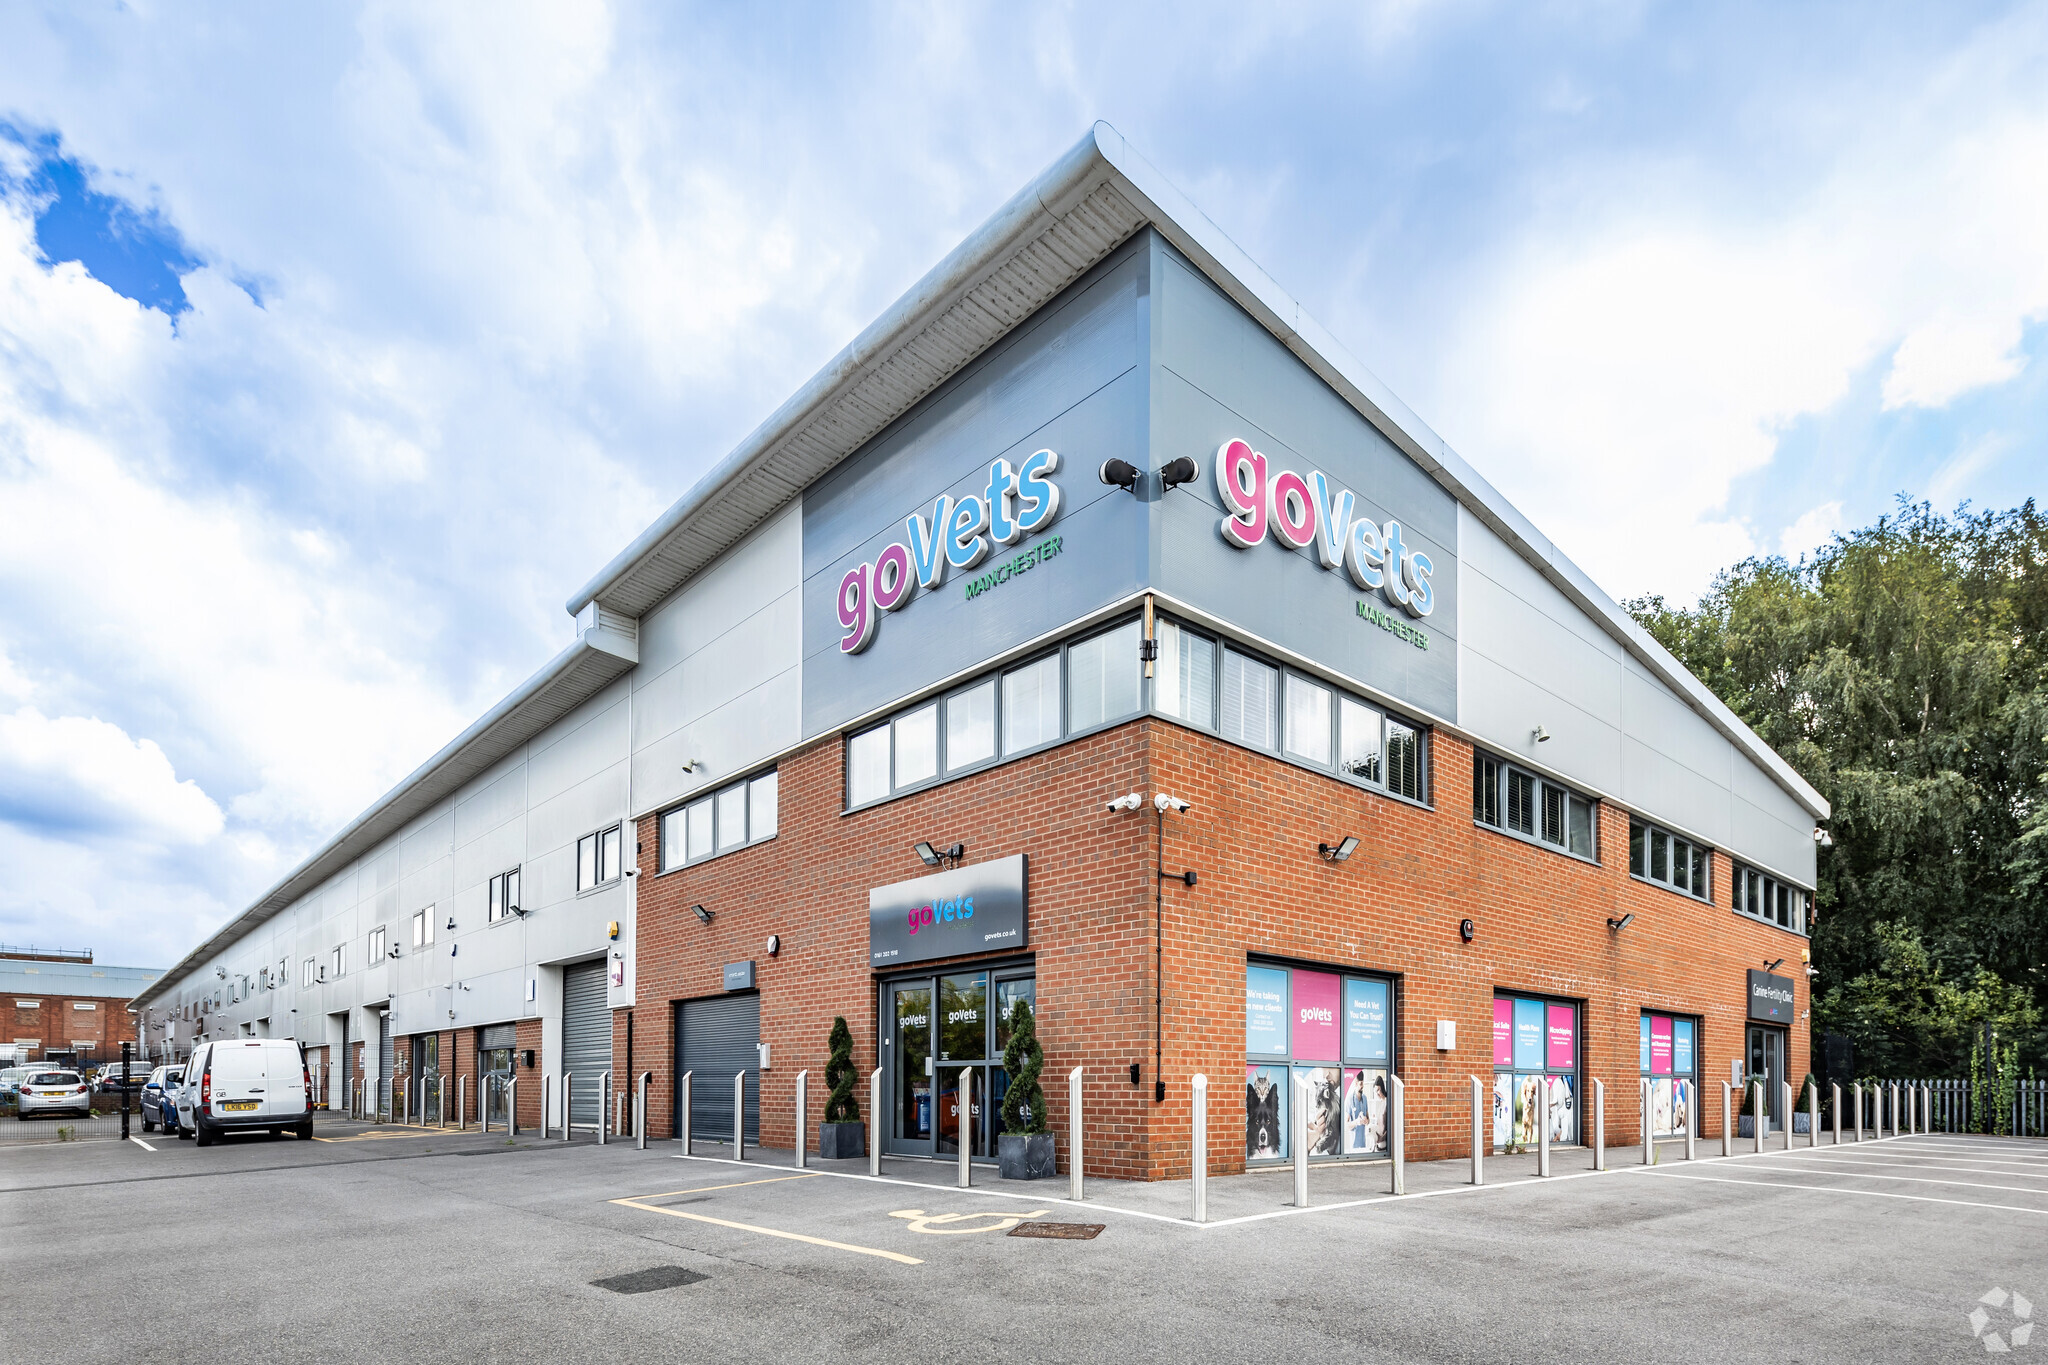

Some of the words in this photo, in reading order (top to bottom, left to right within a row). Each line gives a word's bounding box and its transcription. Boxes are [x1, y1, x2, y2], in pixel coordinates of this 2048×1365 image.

[1215, 438, 1434, 618] goVets
[837, 448, 1059, 654] goVets
[965, 535, 1062, 600] MANCHESTER
[1356, 599, 1430, 651] MANCHESTER
[908, 894, 974, 936] goVets
[1246, 990, 1262, 999] We're
[1262, 992, 1280, 1003] taking
[1354, 999, 1366, 1008] Need
[1367, 1001, 1372, 1009] A
[948, 1008, 977, 1024] goVets
[1252, 1003, 1264, 1011] new
[1264, 1003, 1283, 1012] clients
[1300, 1007, 1332, 1024] goVets
[899, 1014, 926, 1029] goVets
